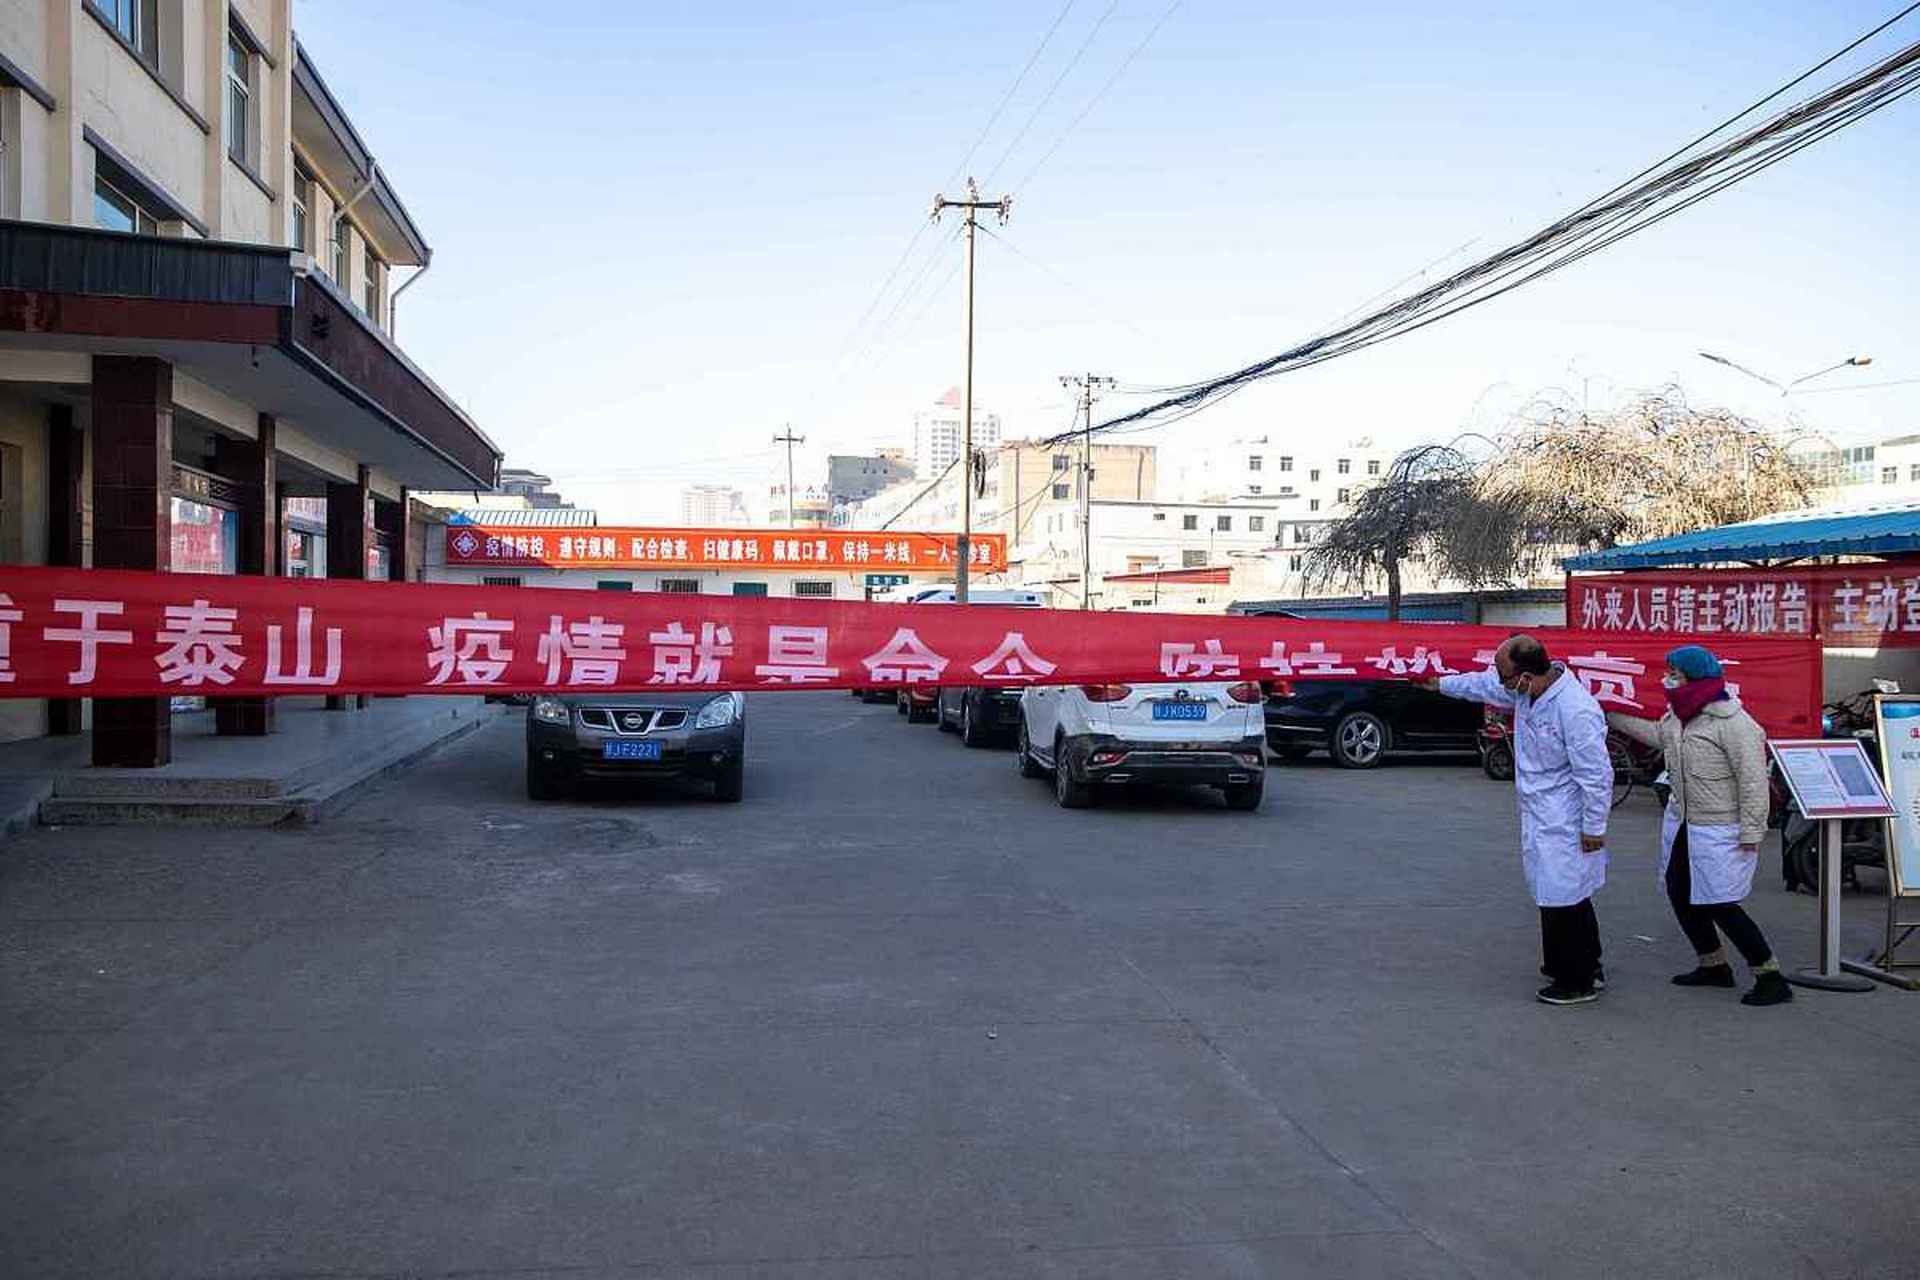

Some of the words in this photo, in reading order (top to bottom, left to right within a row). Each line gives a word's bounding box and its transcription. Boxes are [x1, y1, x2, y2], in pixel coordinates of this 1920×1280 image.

[0, 594, 342, 685] 于泰山
[426, 611, 1058, 685] 疫情就是命令
[1582, 584, 1806, 634] 外来人员请主动报告
